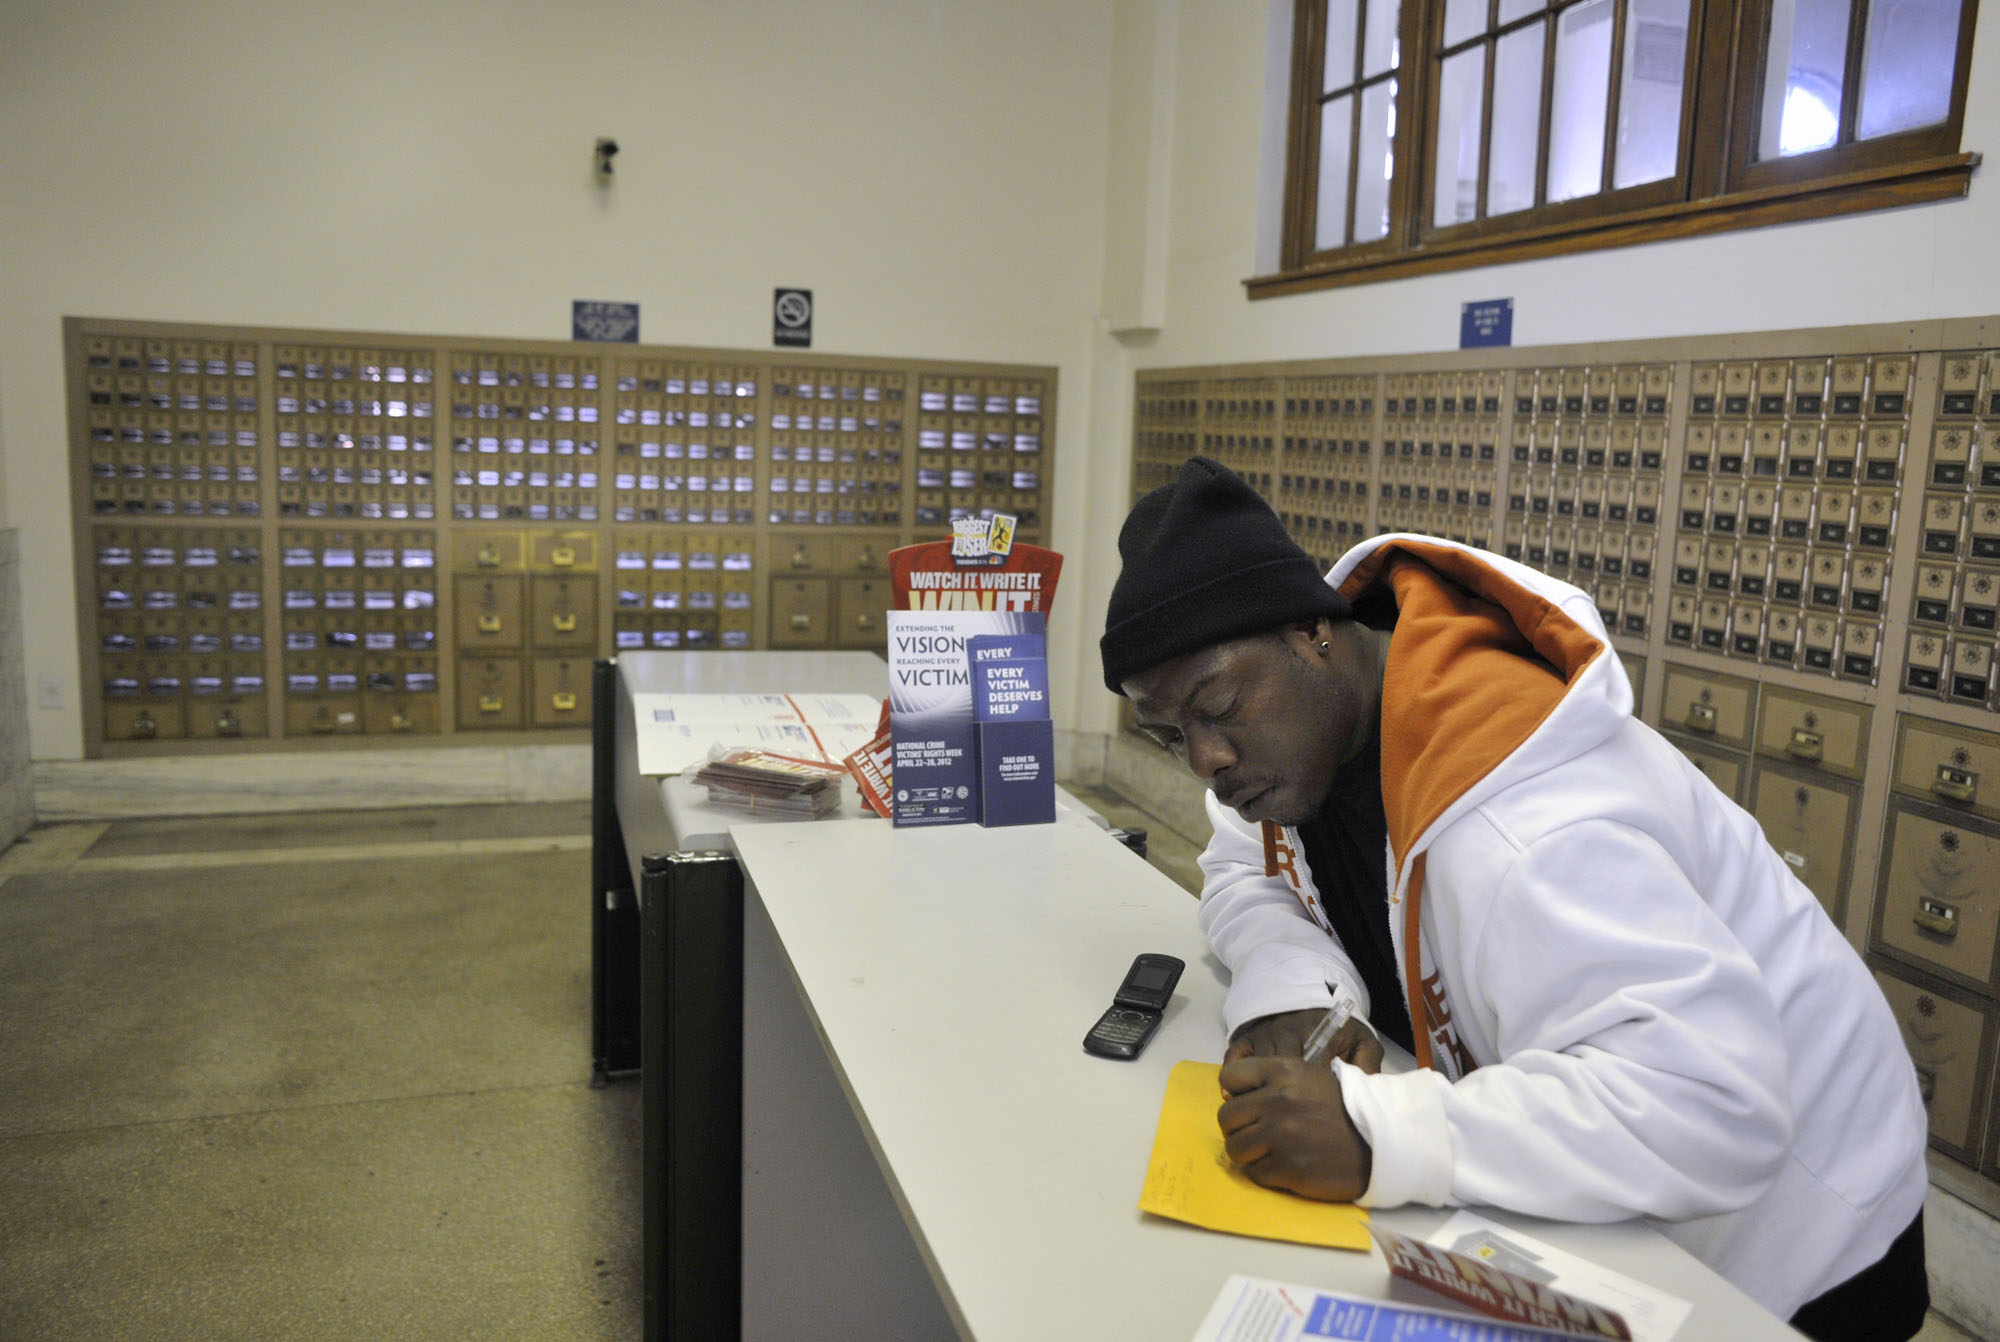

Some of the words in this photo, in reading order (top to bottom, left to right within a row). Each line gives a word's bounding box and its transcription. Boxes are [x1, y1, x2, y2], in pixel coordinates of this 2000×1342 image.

[910, 571, 962, 589] WATCH
[980, 572, 1026, 589] WRITE
[896, 625, 938, 633] EXTENDING
[896, 636, 965, 654] VISION
[976, 647, 1012, 660] EVERY
[896, 658, 935, 666] REACHING
[897, 669, 969, 687] VICTIM
[987, 667, 1024, 679] EVERY
[988, 679, 1030, 690] VICTIM
[989, 690, 1043, 702] DESERVES
[990, 703, 1019, 715] HELP
[860, 761, 890, 799] WRITE
